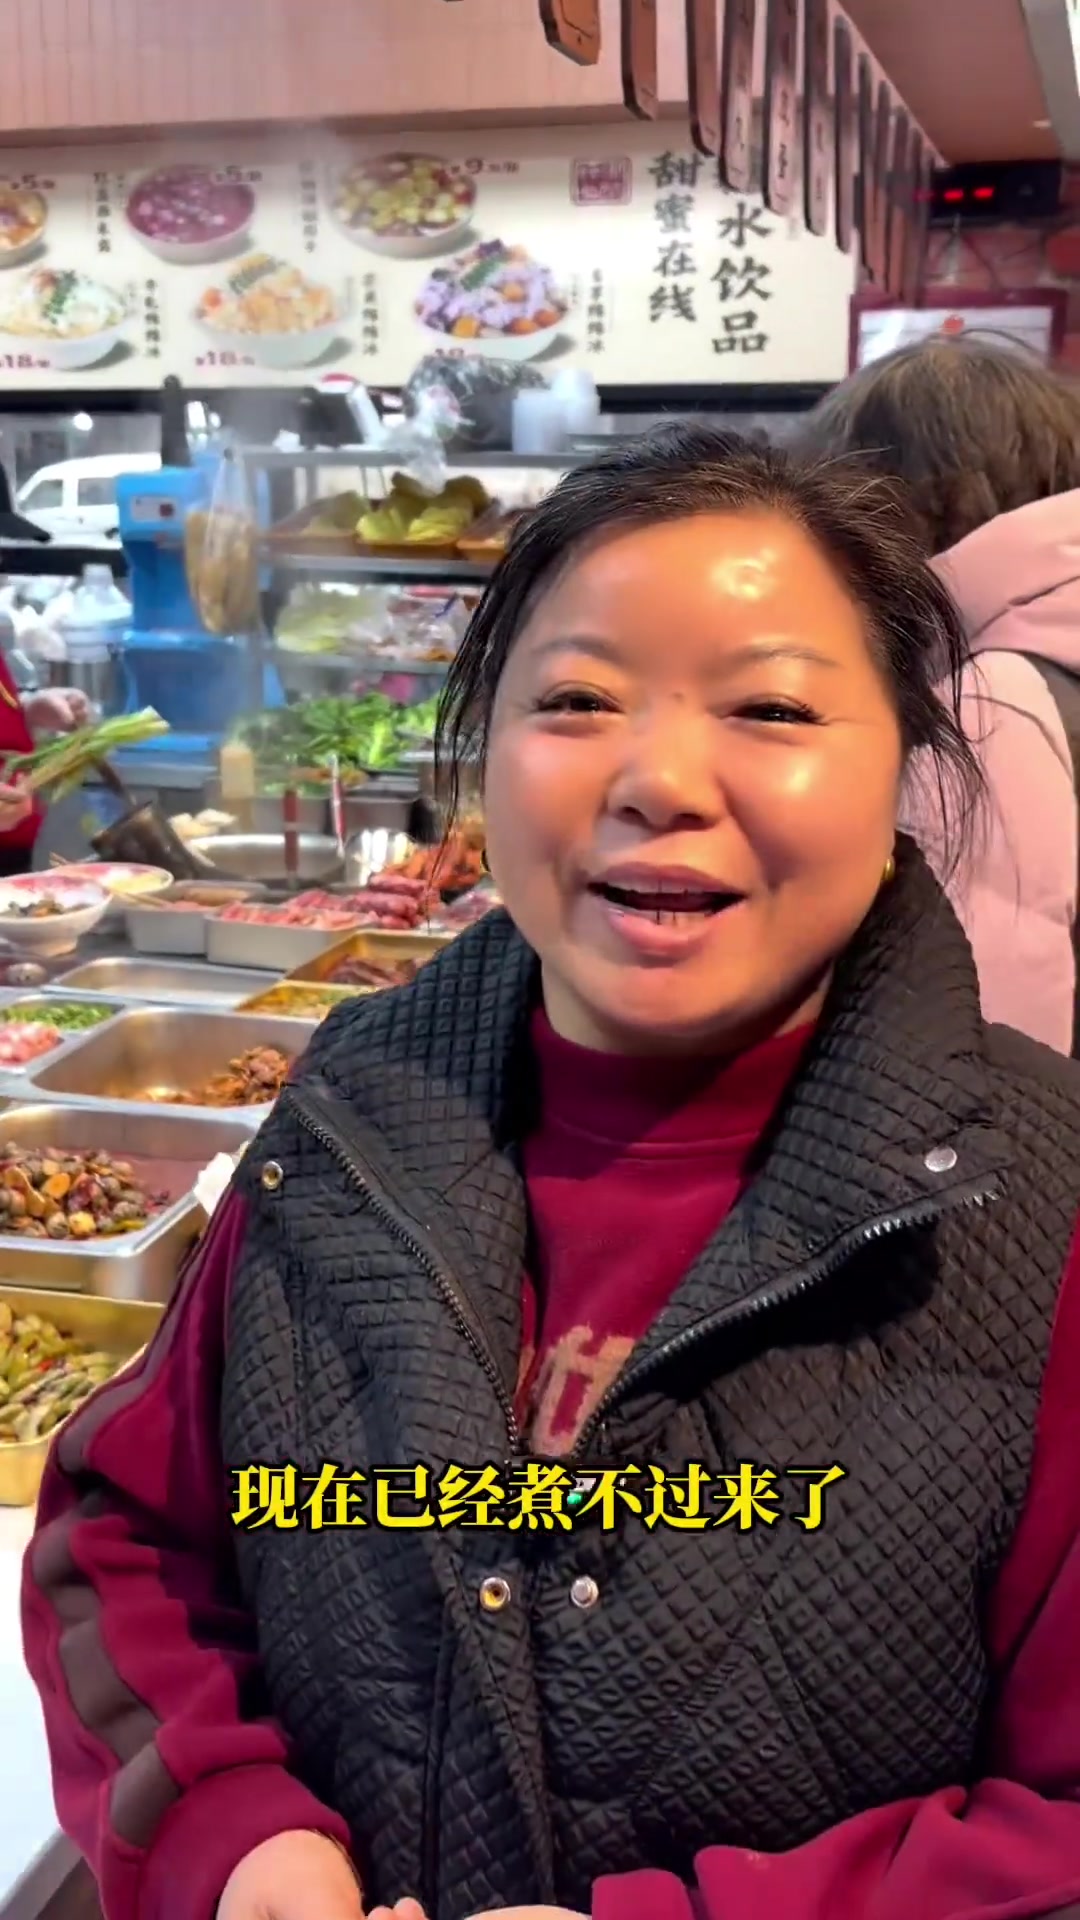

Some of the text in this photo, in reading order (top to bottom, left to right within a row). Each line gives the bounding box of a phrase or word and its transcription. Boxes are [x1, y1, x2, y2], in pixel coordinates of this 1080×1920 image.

[649, 151, 704, 322] 甜蜜在线
[711, 172, 774, 354] 水饮品
